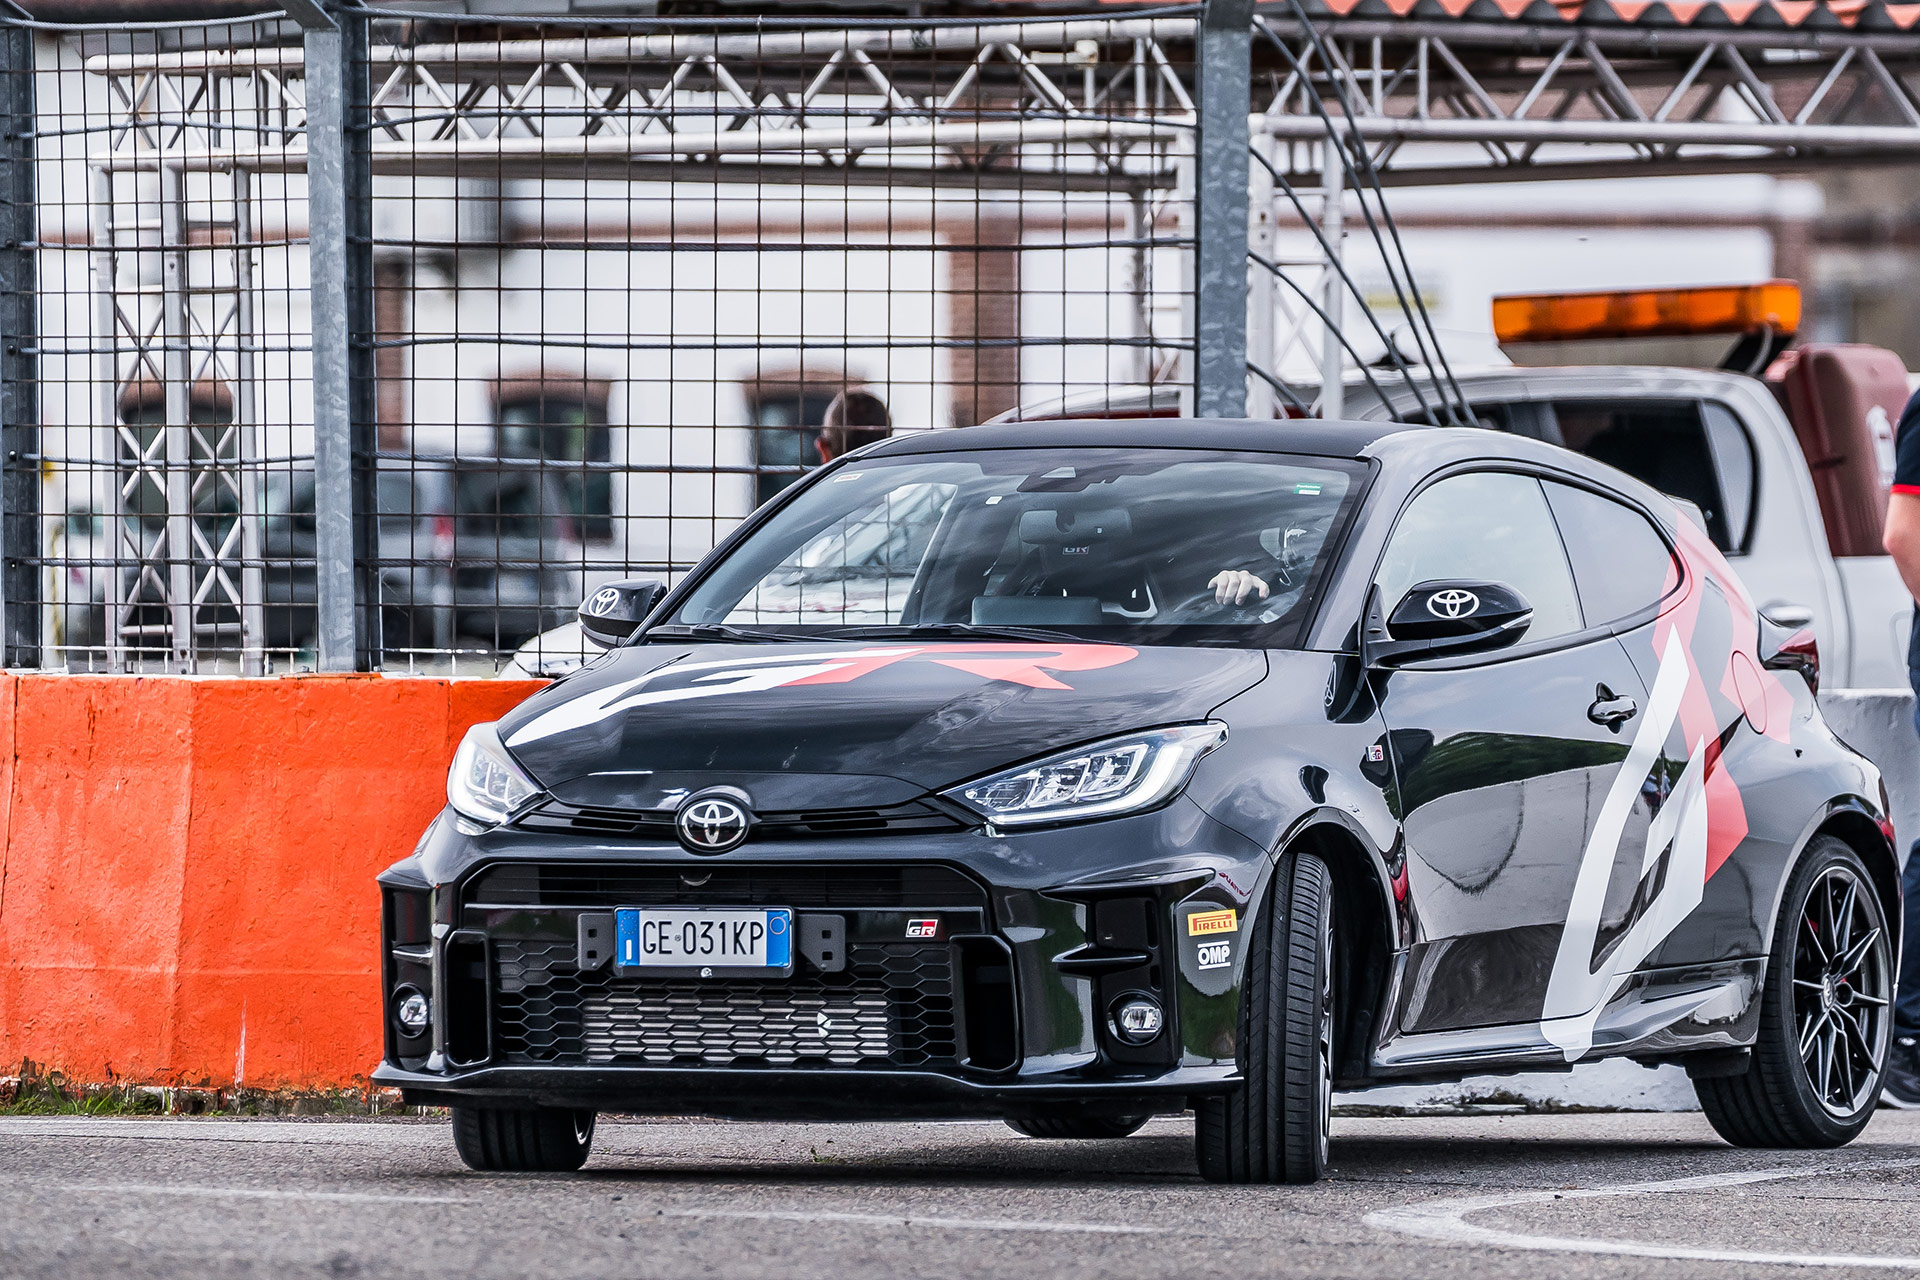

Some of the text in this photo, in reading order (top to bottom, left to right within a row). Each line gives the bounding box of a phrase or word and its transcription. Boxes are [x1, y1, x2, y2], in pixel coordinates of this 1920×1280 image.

[907, 925, 936, 936] GR
[1192, 913, 1233, 932] PIRELLI
[643, 921, 764, 955] GE 031KP
[1198, 945, 1231, 965] OMP
